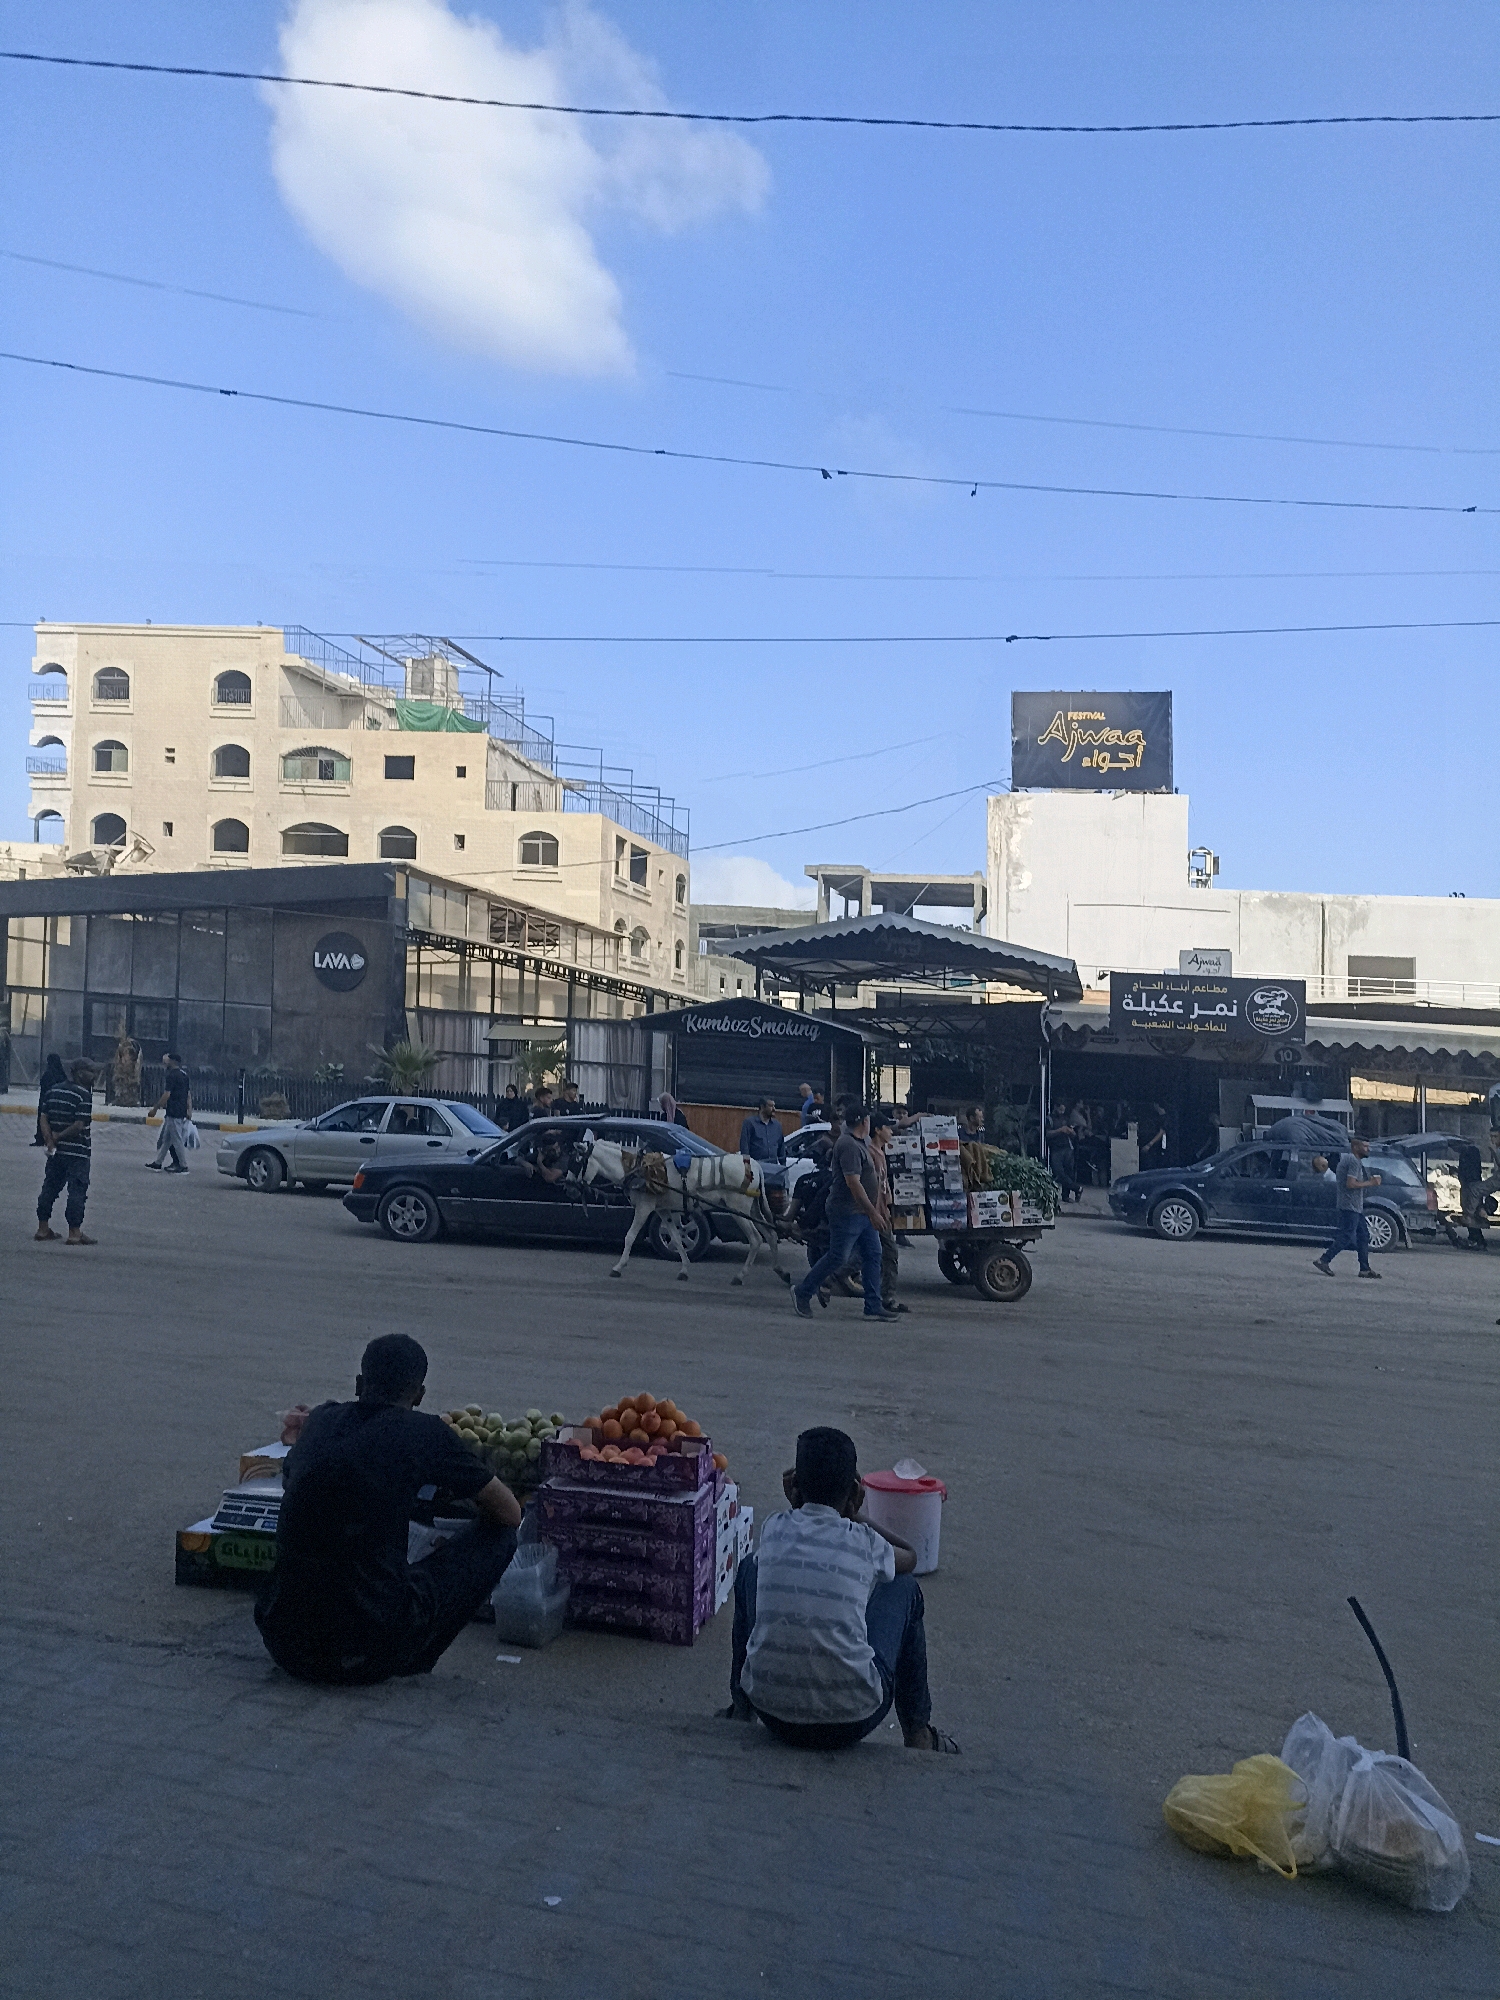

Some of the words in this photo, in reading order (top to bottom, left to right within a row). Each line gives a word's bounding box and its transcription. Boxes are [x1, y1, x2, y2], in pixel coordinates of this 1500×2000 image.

[1068, 711, 1106, 720] FESTIVAL
[1038, 711, 1146, 762] Ajwaa
[315, 952, 350, 969] LAVA
[1132, 980, 1163, 992] الحاج
[1166, 980, 1190, 993] أبناء
[1192, 982, 1227, 995] مطاعم
[1122, 992, 1183, 1017] عكيلة
[1189, 998, 1237, 1019] نمر
[681, 1013, 750, 1033] Kumboz
[749, 1016, 820, 1041] Smoking
[1131, 1019, 1174, 1030] الشعبية
[1176, 1020, 1227, 1033] للمأكولات
[1279, 1050, 1292, 1062] 10
